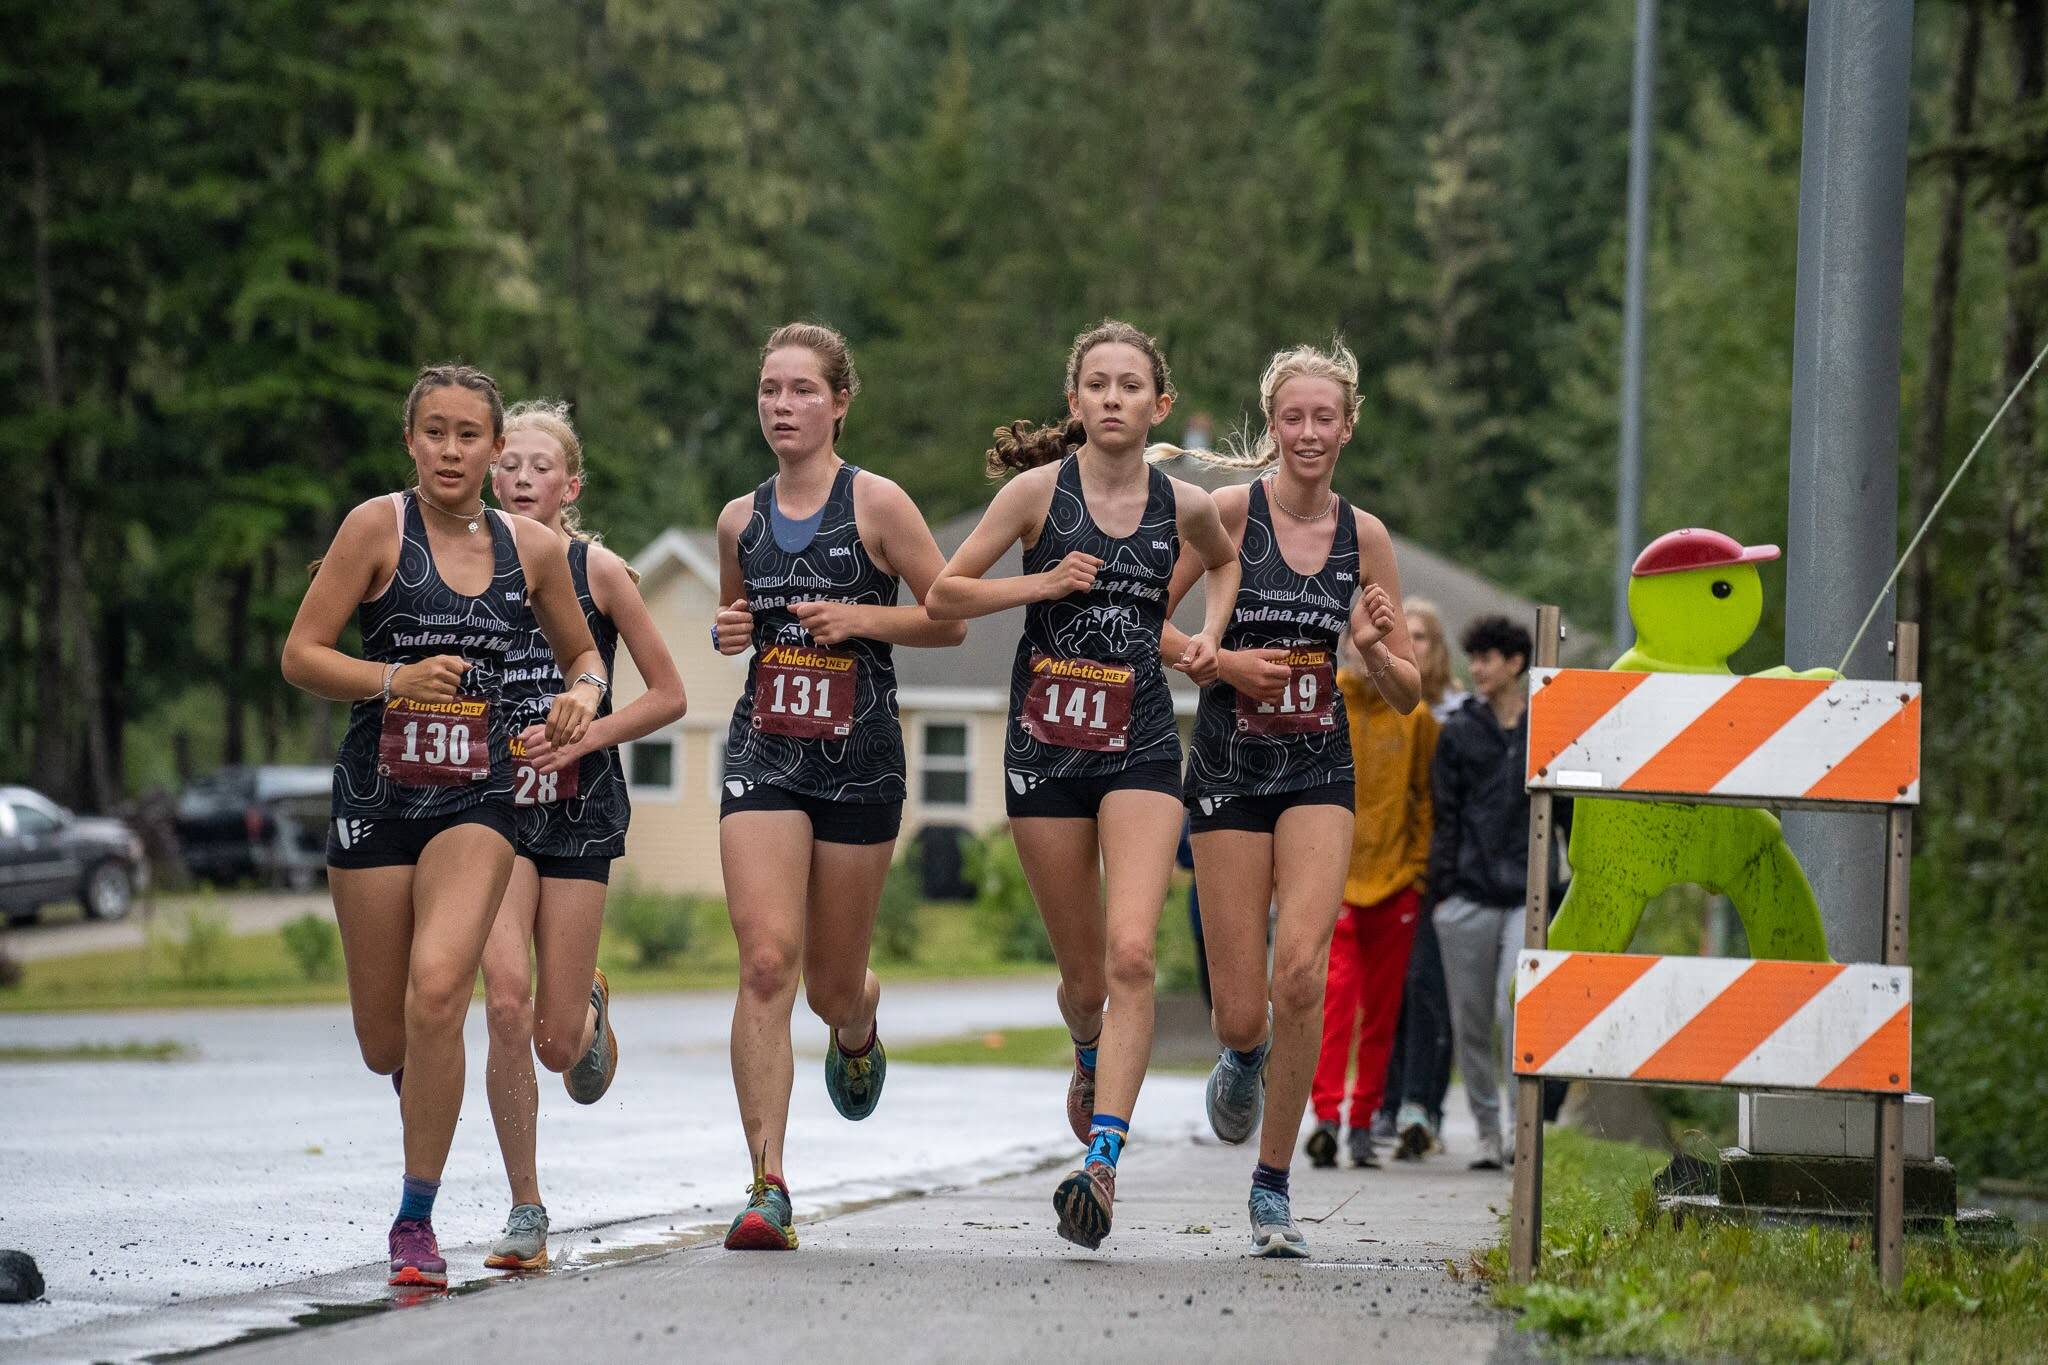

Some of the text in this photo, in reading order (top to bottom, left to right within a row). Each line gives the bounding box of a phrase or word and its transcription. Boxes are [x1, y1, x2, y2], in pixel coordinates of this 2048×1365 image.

[829, 547, 851, 557] BOA
[1152, 541, 1169, 550] BOA
[1113, 561, 1154, 579] Douglas
[1336, 572, 1353, 582] BOA
[789, 574, 832, 589] Douglas
[505, 592, 521, 601] BOA
[750, 593, 809, 612] adaa.at
[1259, 588, 1340, 610] Juneau Douglas
[418, 613, 510, 632] Juneau Douglas
[1318, 613, 1347, 634] Kal
[530, 646, 554, 660] Doug
[762, 647, 826, 669] Athletic
[1033, 657, 1104, 680] Athletic
[771, 674, 832, 718] 131
[1257, 674, 1317, 713] 19
[1043, 684, 1108, 729] 141
[401, 721, 469, 766] 130
[514, 765, 558, 804] 28
